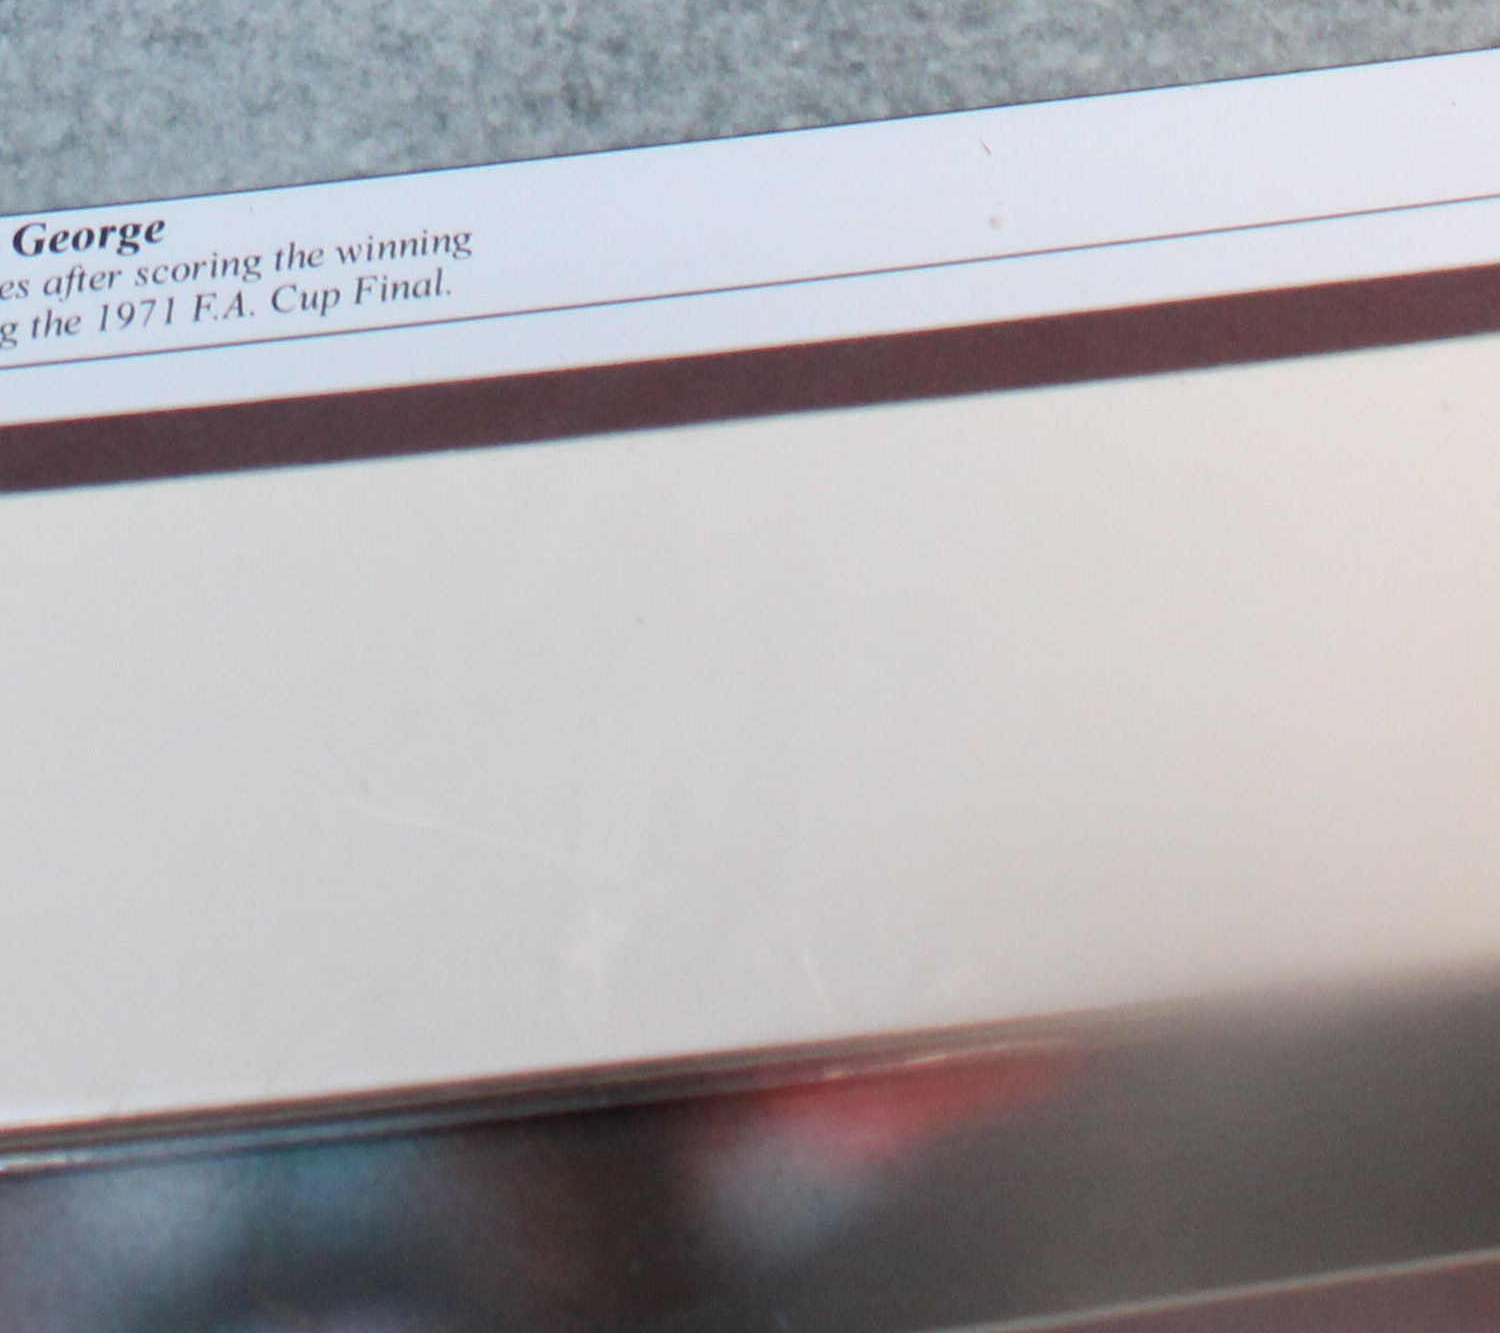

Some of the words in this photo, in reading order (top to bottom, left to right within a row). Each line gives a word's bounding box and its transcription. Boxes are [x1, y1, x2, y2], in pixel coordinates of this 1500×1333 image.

[11, 219, 166, 258] George
[42, 264, 123, 303] after
[134, 251, 263, 287] scoring
[274, 240, 325, 273] the
[334, 228, 473, 265] winning
[31, 308, 82, 340] the
[98, 296, 175, 333] 1971
[192, 290, 255, 323] F.A.
[270, 283, 341, 318] Cup
[353, 266, 452, 306] Final.
